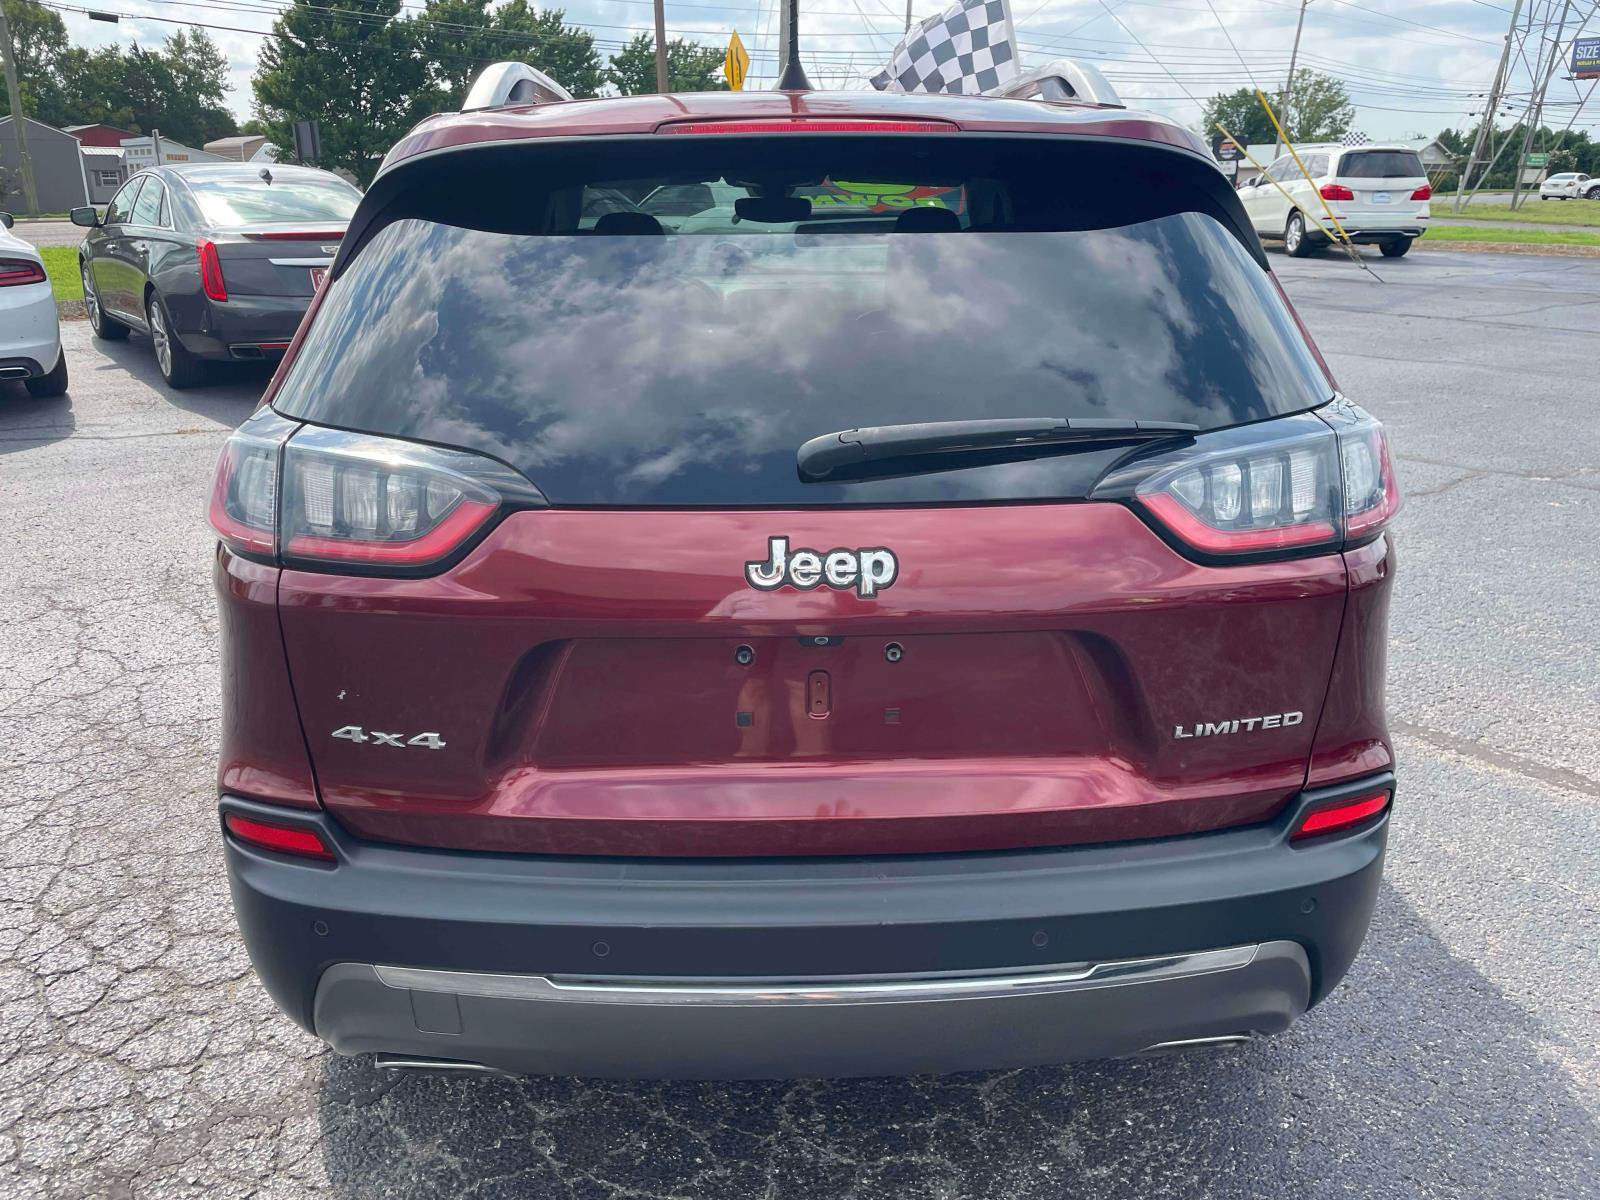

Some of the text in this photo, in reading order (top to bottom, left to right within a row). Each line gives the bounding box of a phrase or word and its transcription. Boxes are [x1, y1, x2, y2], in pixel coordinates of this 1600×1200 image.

[746, 537, 898, 597] Jeep
[331, 725, 447, 749] 4x4
[1174, 711, 1303, 739] LIMITED
